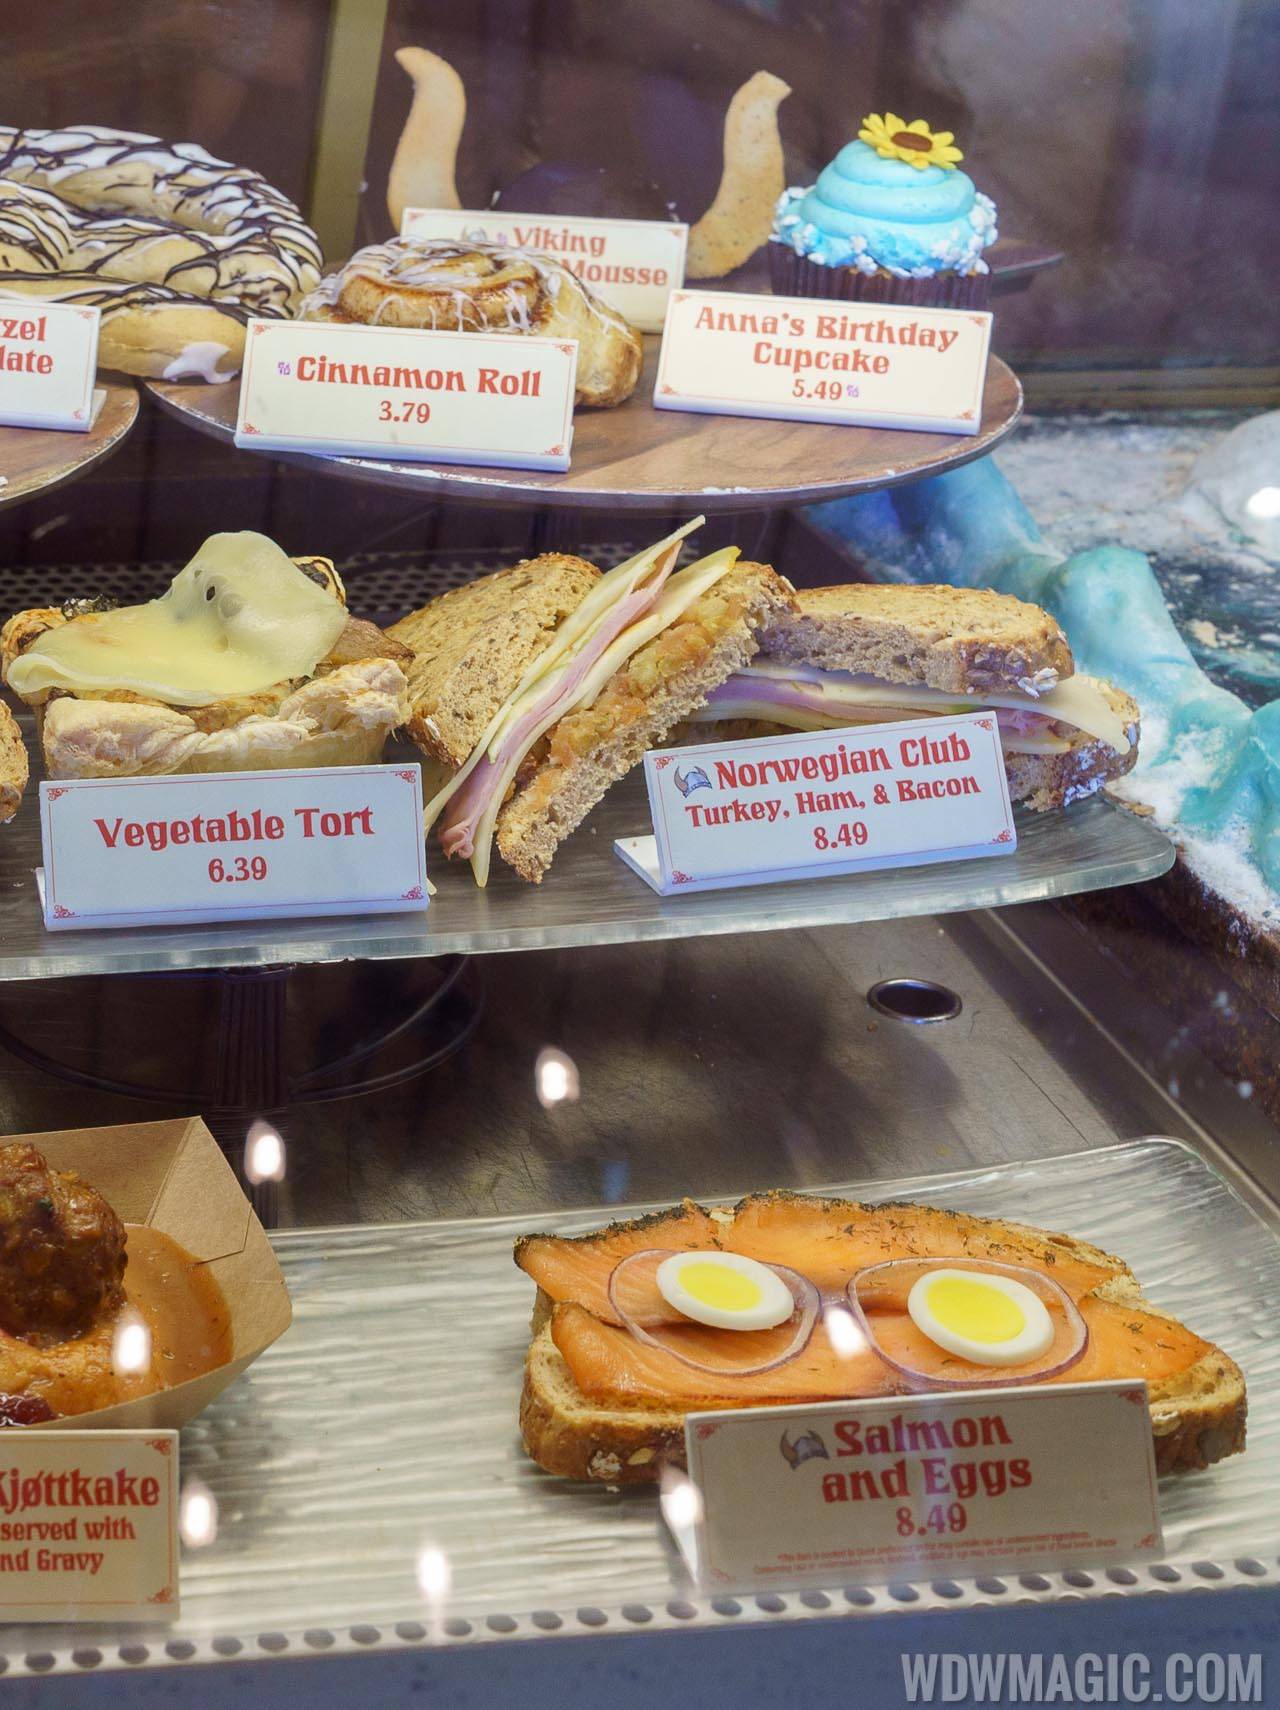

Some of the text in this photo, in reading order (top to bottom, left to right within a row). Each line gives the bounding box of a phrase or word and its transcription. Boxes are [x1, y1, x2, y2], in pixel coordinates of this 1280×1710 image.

[513, 225, 607, 256] Viking
[695, 307, 959, 352] Anna's Birthday
[754, 342, 890, 374] Cupcake
[296, 356, 541, 396] Cinnamon Roll
[792, 379, 842, 400] 5.49
[379, 401, 431, 424] 3.79
[714, 732, 970, 790] Norwegian Club
[685, 774, 981, 827] Turkey, Ham, & Bacon
[93, 805, 374, 851] Vegetable Tort
[813, 822, 869, 850] 8.49
[208, 856, 267, 883] 6.39
[833, 1414, 1013, 1457] Salmon
[823, 1456, 1033, 1502] and Eggs
[0, 1518, 78, 1540] served
[84, 1516, 135, 1540] with
[895, 1502, 968, 1537] 8.49
[37, 1548, 104, 1575] Gravy
